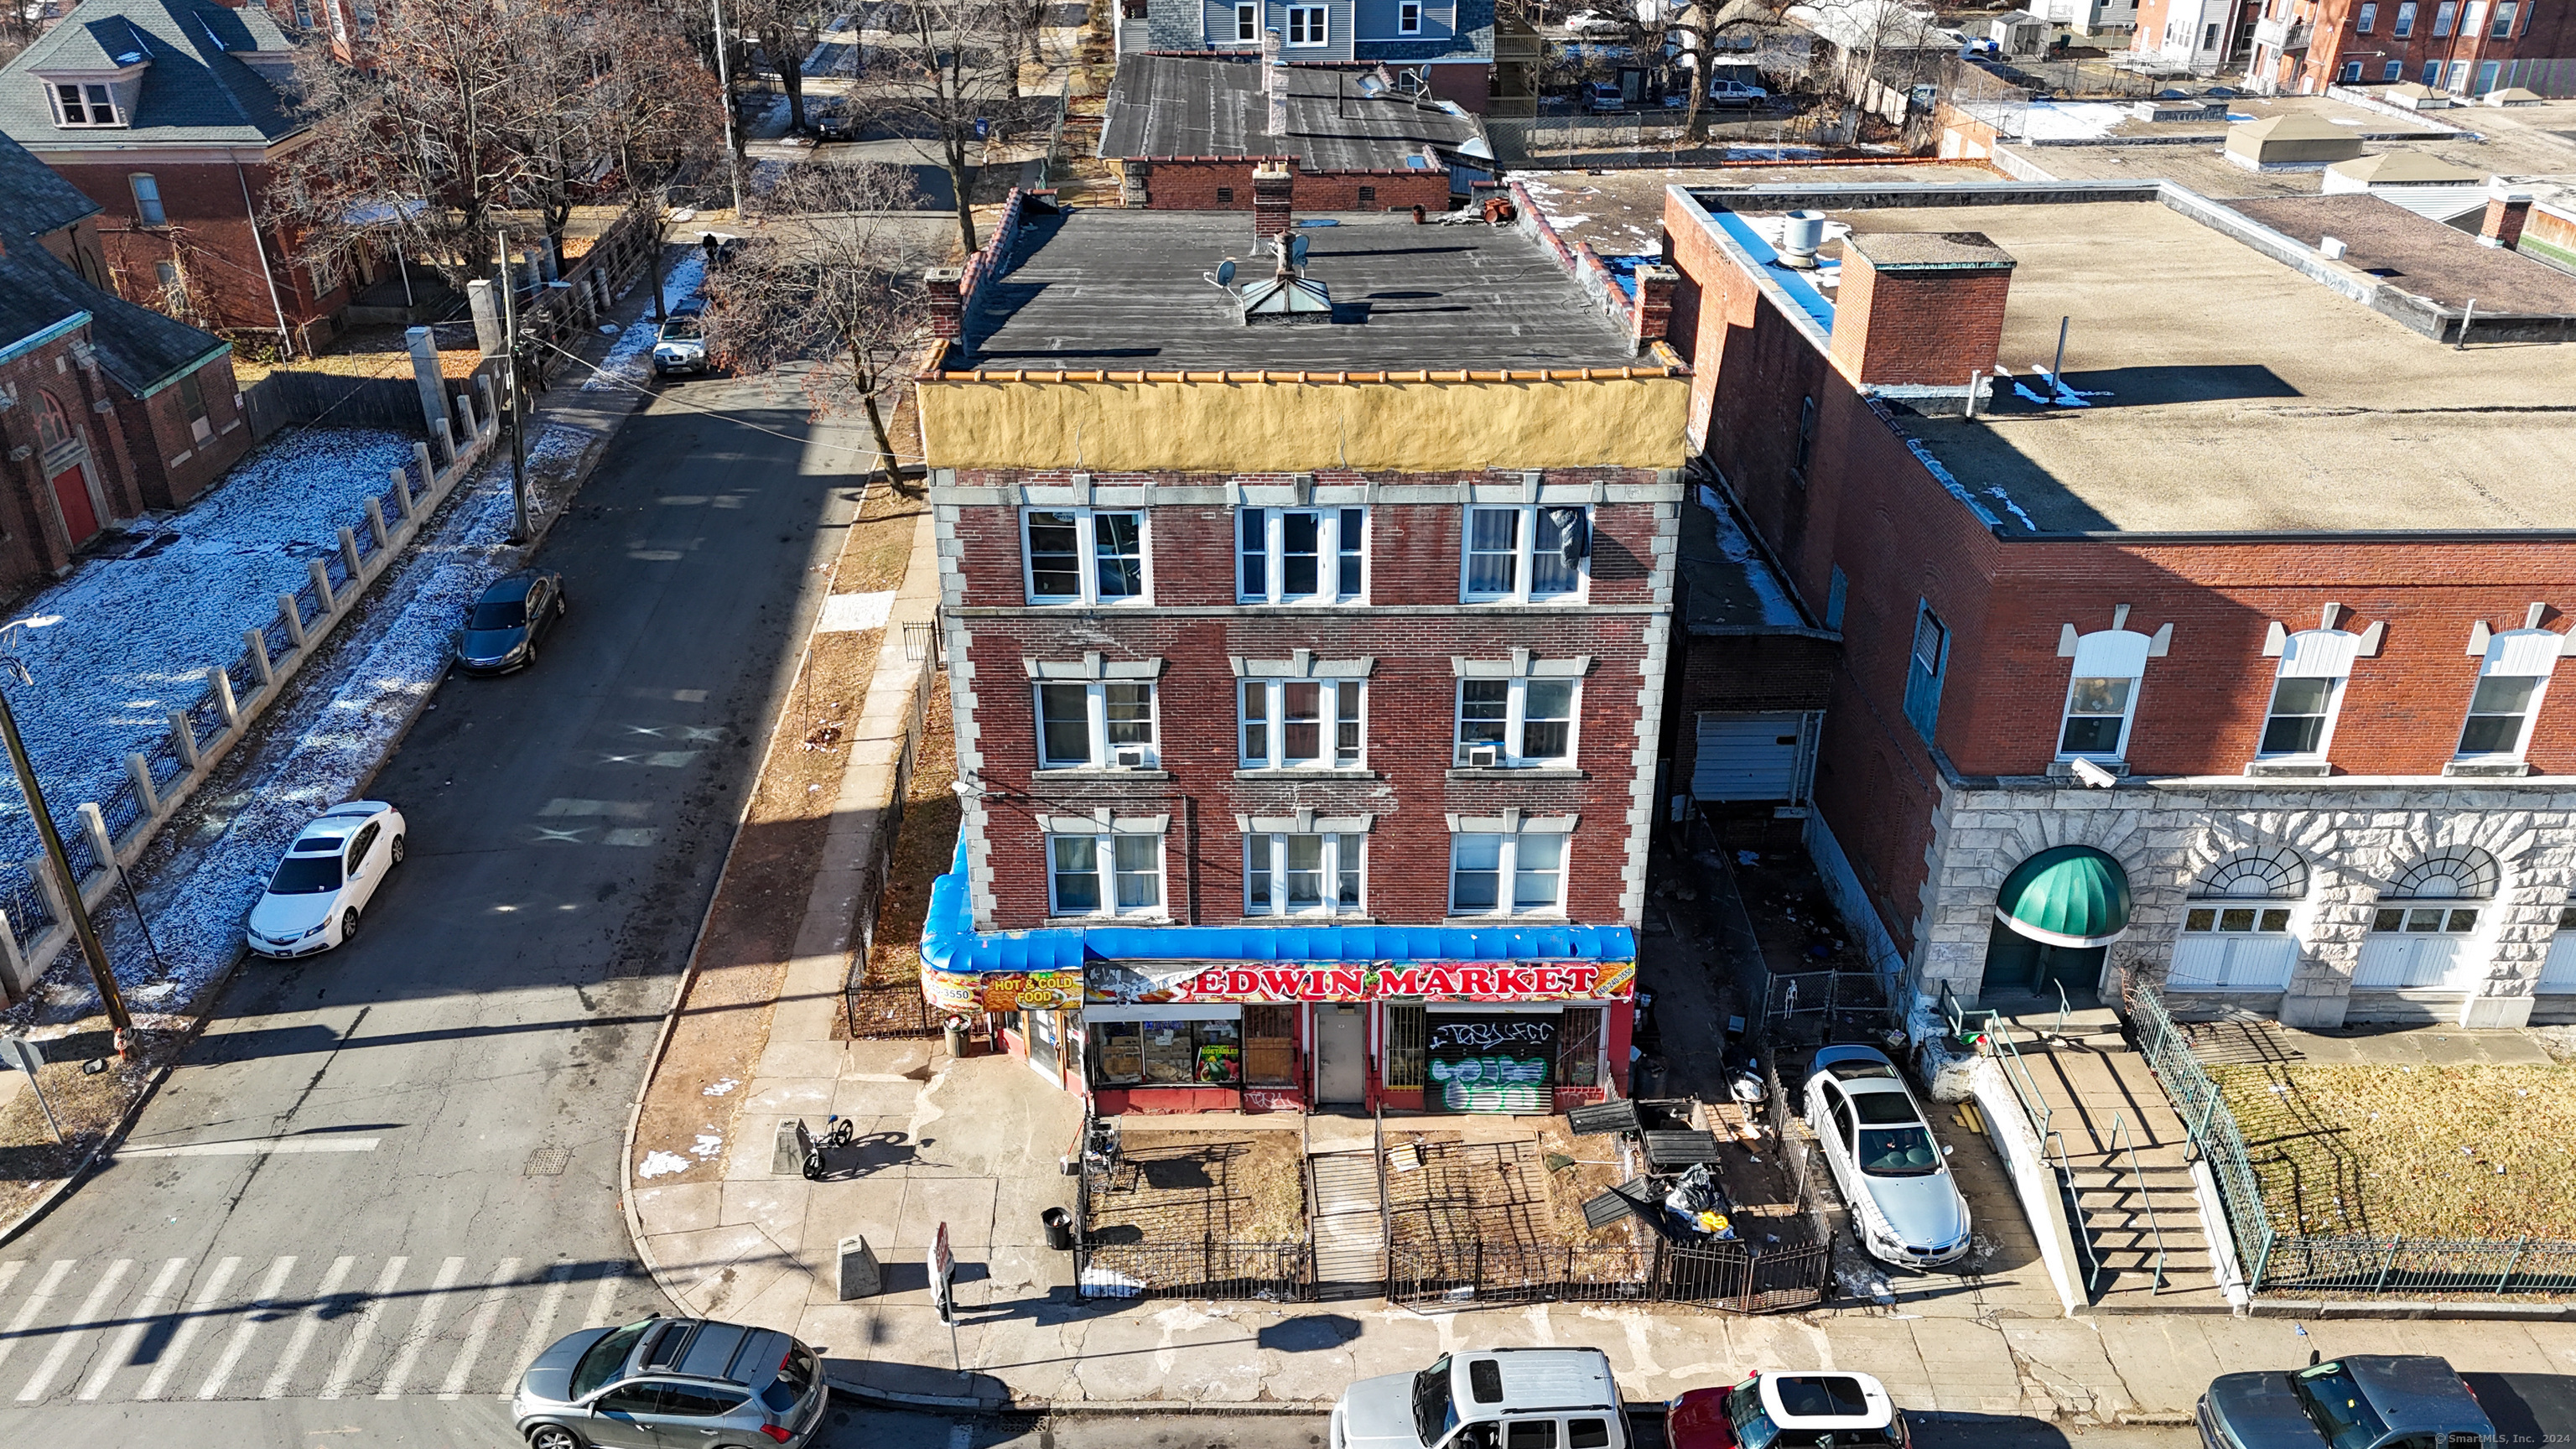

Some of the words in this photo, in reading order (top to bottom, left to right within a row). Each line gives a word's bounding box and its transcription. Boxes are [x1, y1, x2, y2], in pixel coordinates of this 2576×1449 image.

[995, 979, 1021, 991] HOT
[1025, 979, 1036, 990] &
[1038, 978, 1073, 989] COLD
[1193, 969, 1366, 996] EDWIN
[1377, 965, 1599, 996] MARKET
[1597, 968, 1633, 996] 860-240-3550
[1016, 990, 1052, 1004] FOOD
[937, 1227, 948, 1267] STOP
